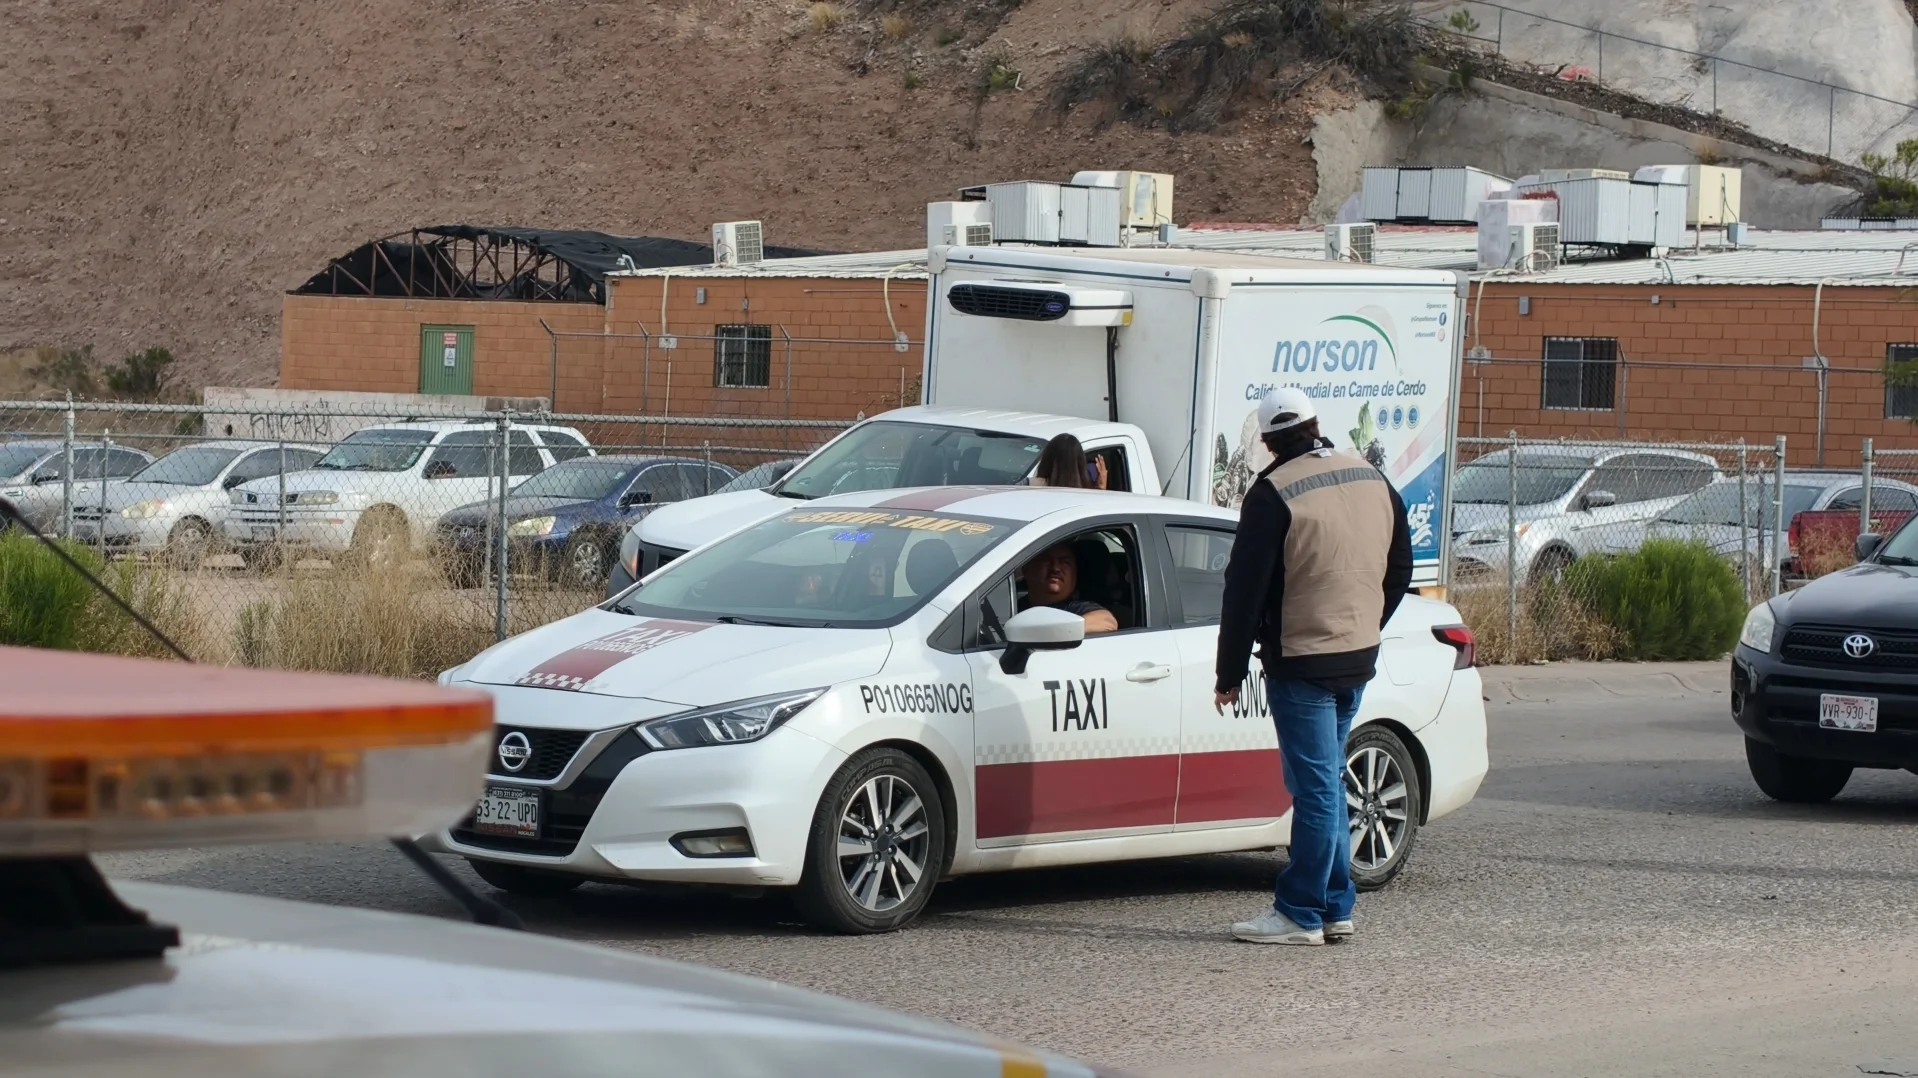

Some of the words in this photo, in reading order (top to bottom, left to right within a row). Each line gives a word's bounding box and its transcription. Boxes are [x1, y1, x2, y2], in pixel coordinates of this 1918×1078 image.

[1271, 339, 1378, 373] norson
[1333, 385, 1346, 398] en
[1381, 380, 1394, 397] de
[1396, 380, 1426, 396] Cerdo
[888, 515, 970, 532] TAXI
[602, 627, 696, 649] TAXI
[860, 683, 974, 714] P010665NOG
[1043, 678, 1108, 732] TAXI
[1822, 703, 1875, 722] VVR-930-C
